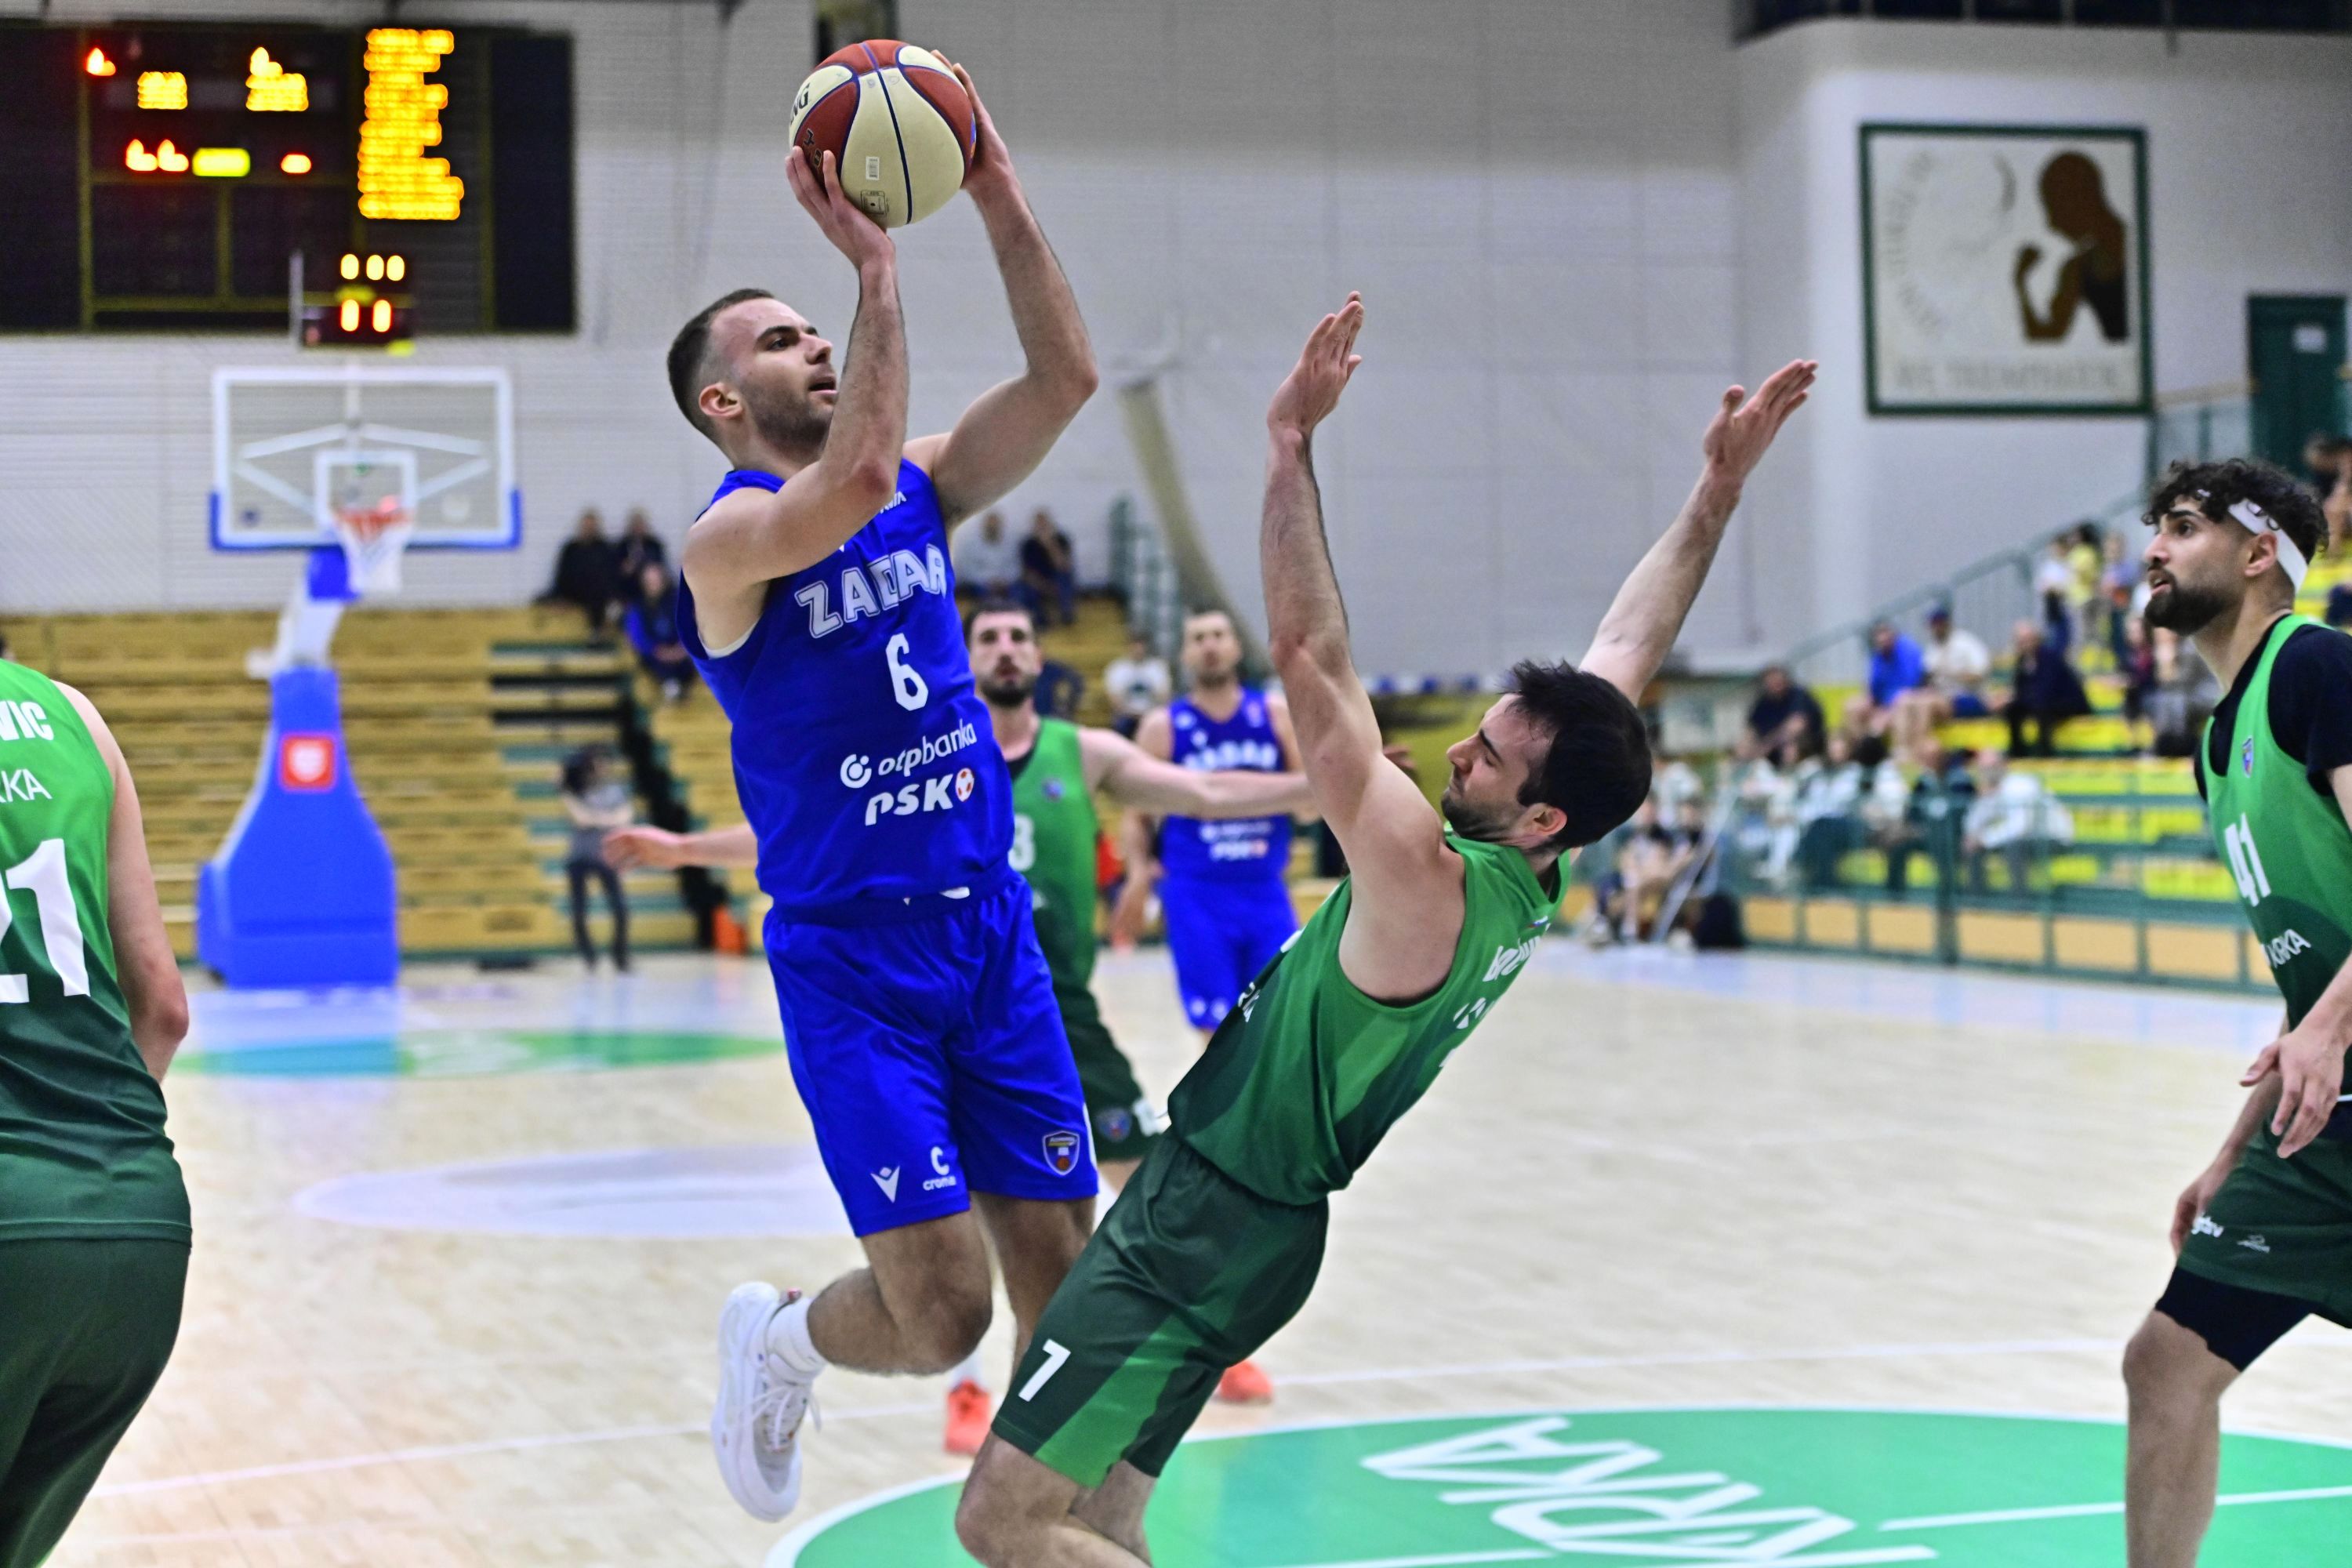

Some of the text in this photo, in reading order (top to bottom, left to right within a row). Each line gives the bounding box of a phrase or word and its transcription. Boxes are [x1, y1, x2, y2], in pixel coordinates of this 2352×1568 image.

[885, 633, 929, 711] 6
[0, 768, 53, 804] KA
[1018, 1338, 1072, 1403] 7
[1359, 1416, 1938, 1568] KRKA
